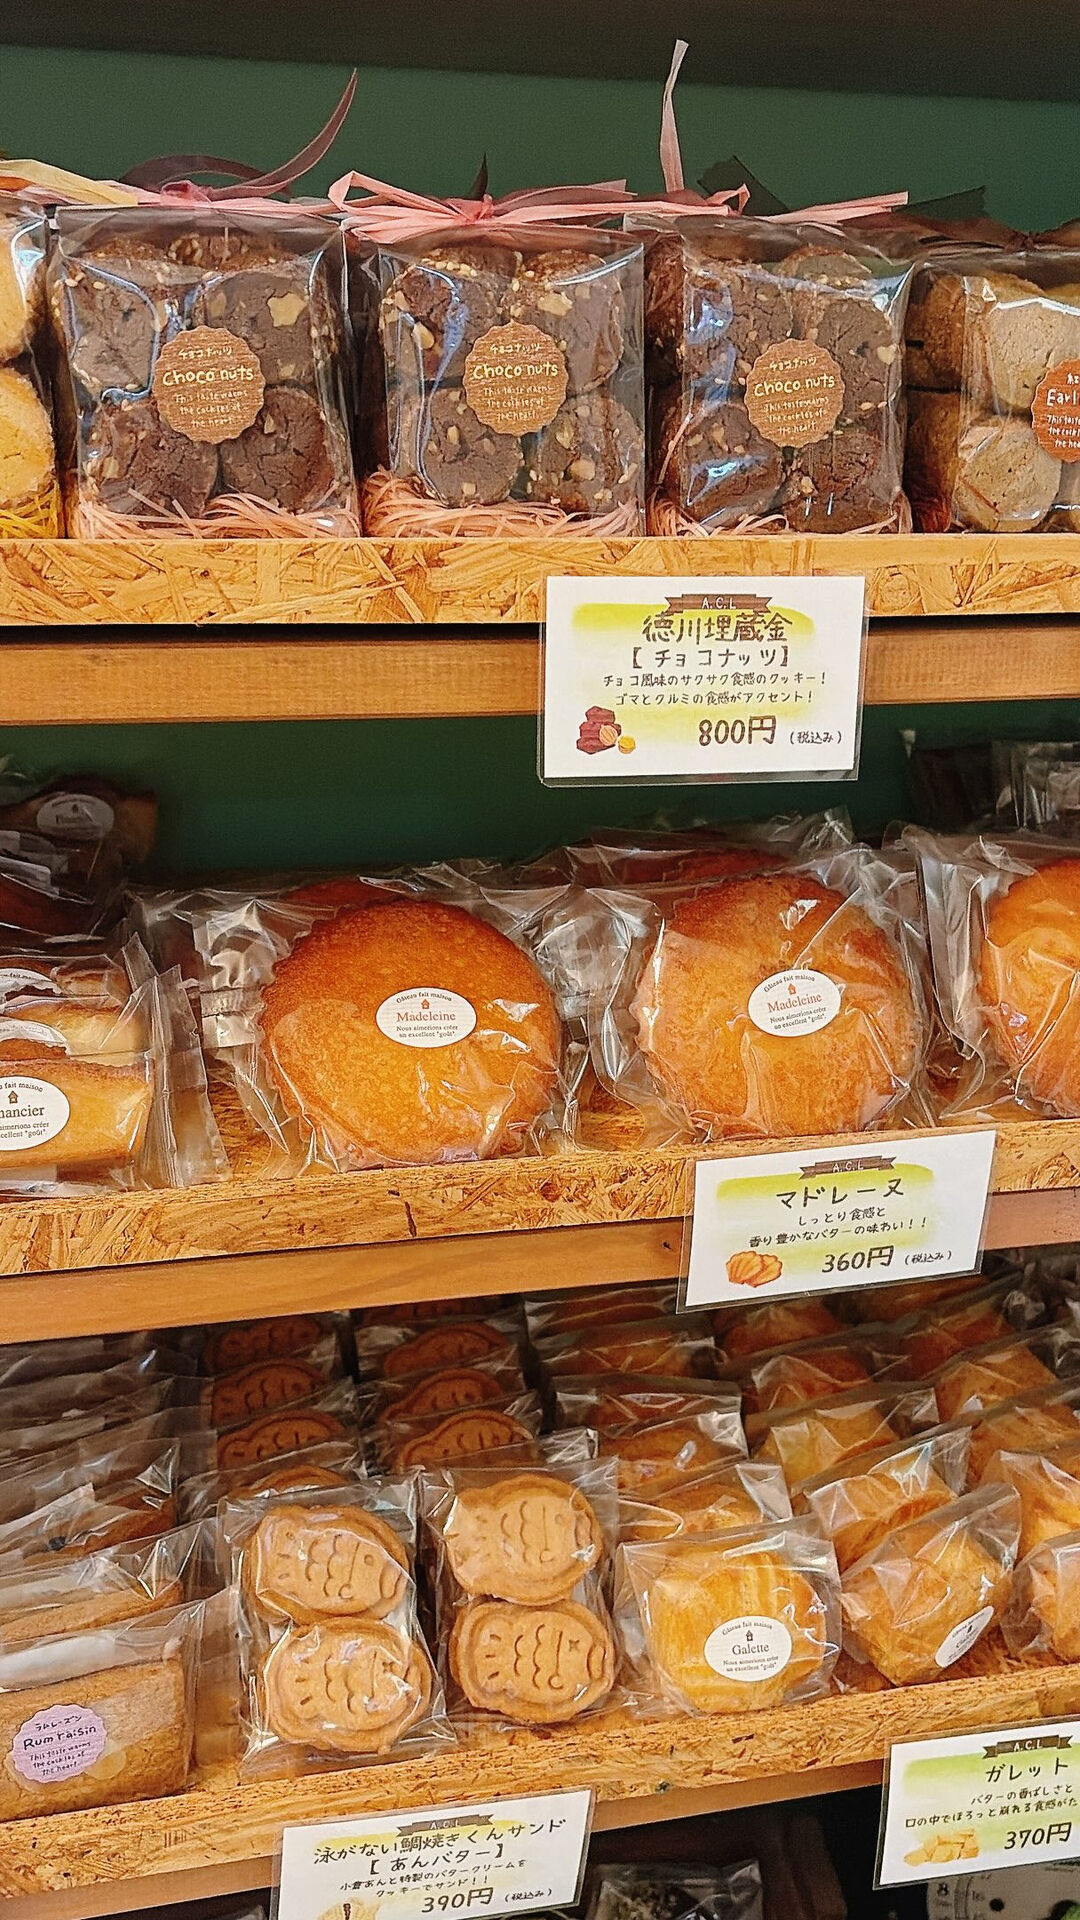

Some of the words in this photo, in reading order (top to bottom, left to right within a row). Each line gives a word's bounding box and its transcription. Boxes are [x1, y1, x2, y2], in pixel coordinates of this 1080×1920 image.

[178, 345, 232, 360] チョコナッツ
[490, 343, 540, 354] チョコナッツ
[162, 368, 215, 386] Choco
[219, 364, 254, 381] nuts
[473, 364, 522, 379] Choco
[527, 361, 558, 376] nuts
[805, 373, 835, 388] nuts
[1047, 388, 1076, 406] Earl
[702, 597, 736, 609] A.C.L
[642, 611, 793, 645] 徳川埋蔵金
[603, 671, 826, 687] チョコ風味のサクサク食感のクッキー！
[615, 690, 813, 706] ゴマとクルミの食感がアクセント！
[698, 715, 777, 746] 800円
[767, 993, 822, 1013] Madeleine
[396, 1011, 456, 1022] Madeleine
[18, 1082, 44, 1092] maison
[833, 1160, 864, 1173] A.C.L
[776, 1178, 904, 1209] マドレーヌ
[798, 1206, 886, 1226] しっとり食感と
[821, 1245, 895, 1273] 360円
[731, 1643, 770, 1656] Galette
[35, 1715, 82, 1732] ラムレーズン
[23, 1736, 54, 1751] Rum
[57, 1725, 96, 1741] raisin
[1013, 1740, 1044, 1752] A.C.L
[30, 1753, 45, 1762] This
[33, 1760, 45, 1769] the
[985, 1756, 1069, 1783] ガレット
[970, 1784, 1073, 1805] バターの香ばしさと
[313, 1819, 566, 1864] 泳がない鯛焼きくんサンド
[1003, 1822, 1073, 1850] 370円
[370, 1843, 504, 1876] 【あんバター】
[421, 1887, 494, 1913] 390円
